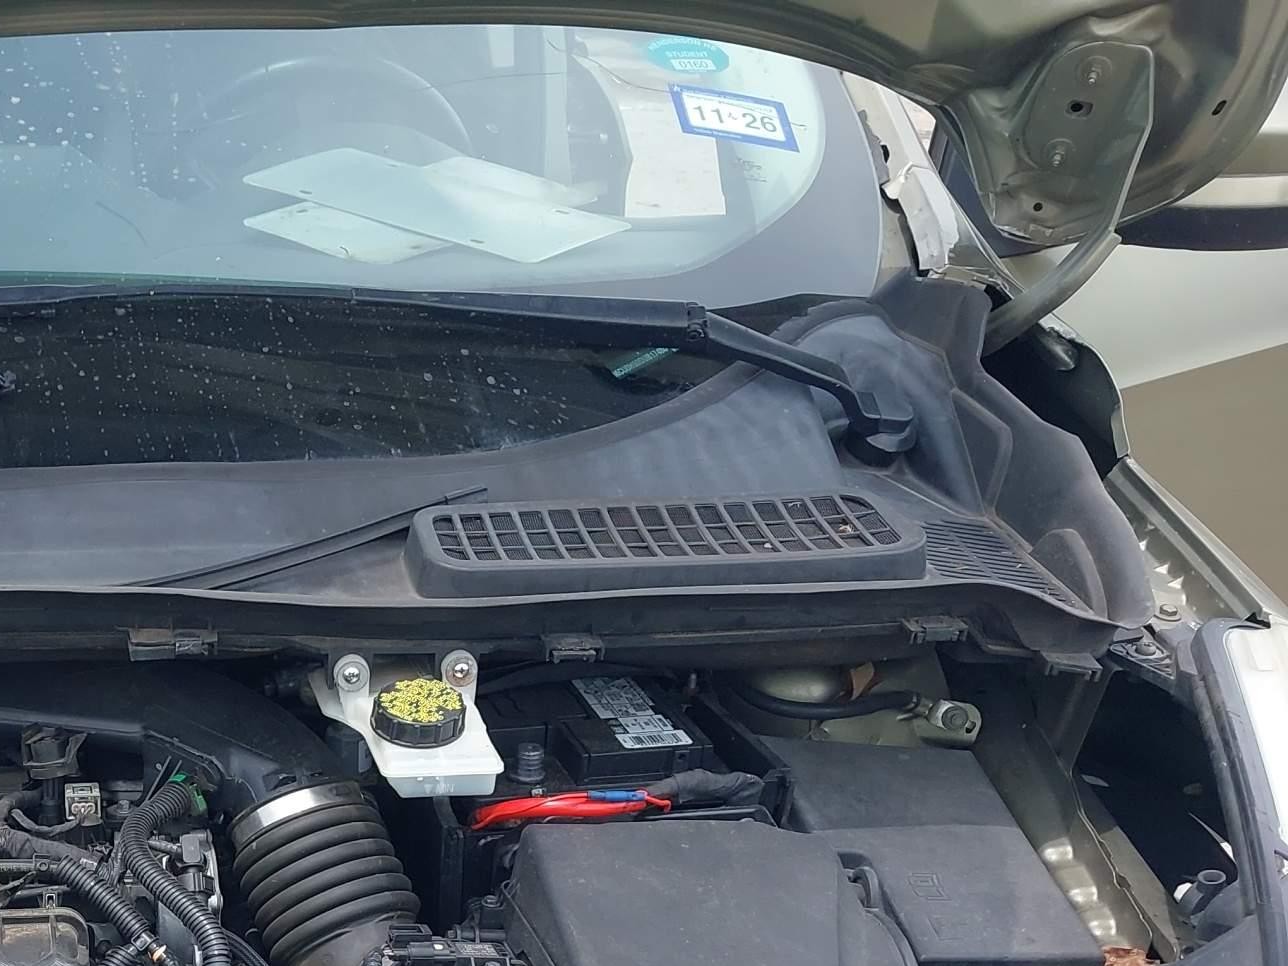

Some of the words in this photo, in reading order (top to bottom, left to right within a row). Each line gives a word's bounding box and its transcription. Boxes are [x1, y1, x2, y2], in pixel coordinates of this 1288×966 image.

[693, 105, 724, 124] 11
[741, 112, 777, 133] 26
[435, 783, 454, 794] MIN
